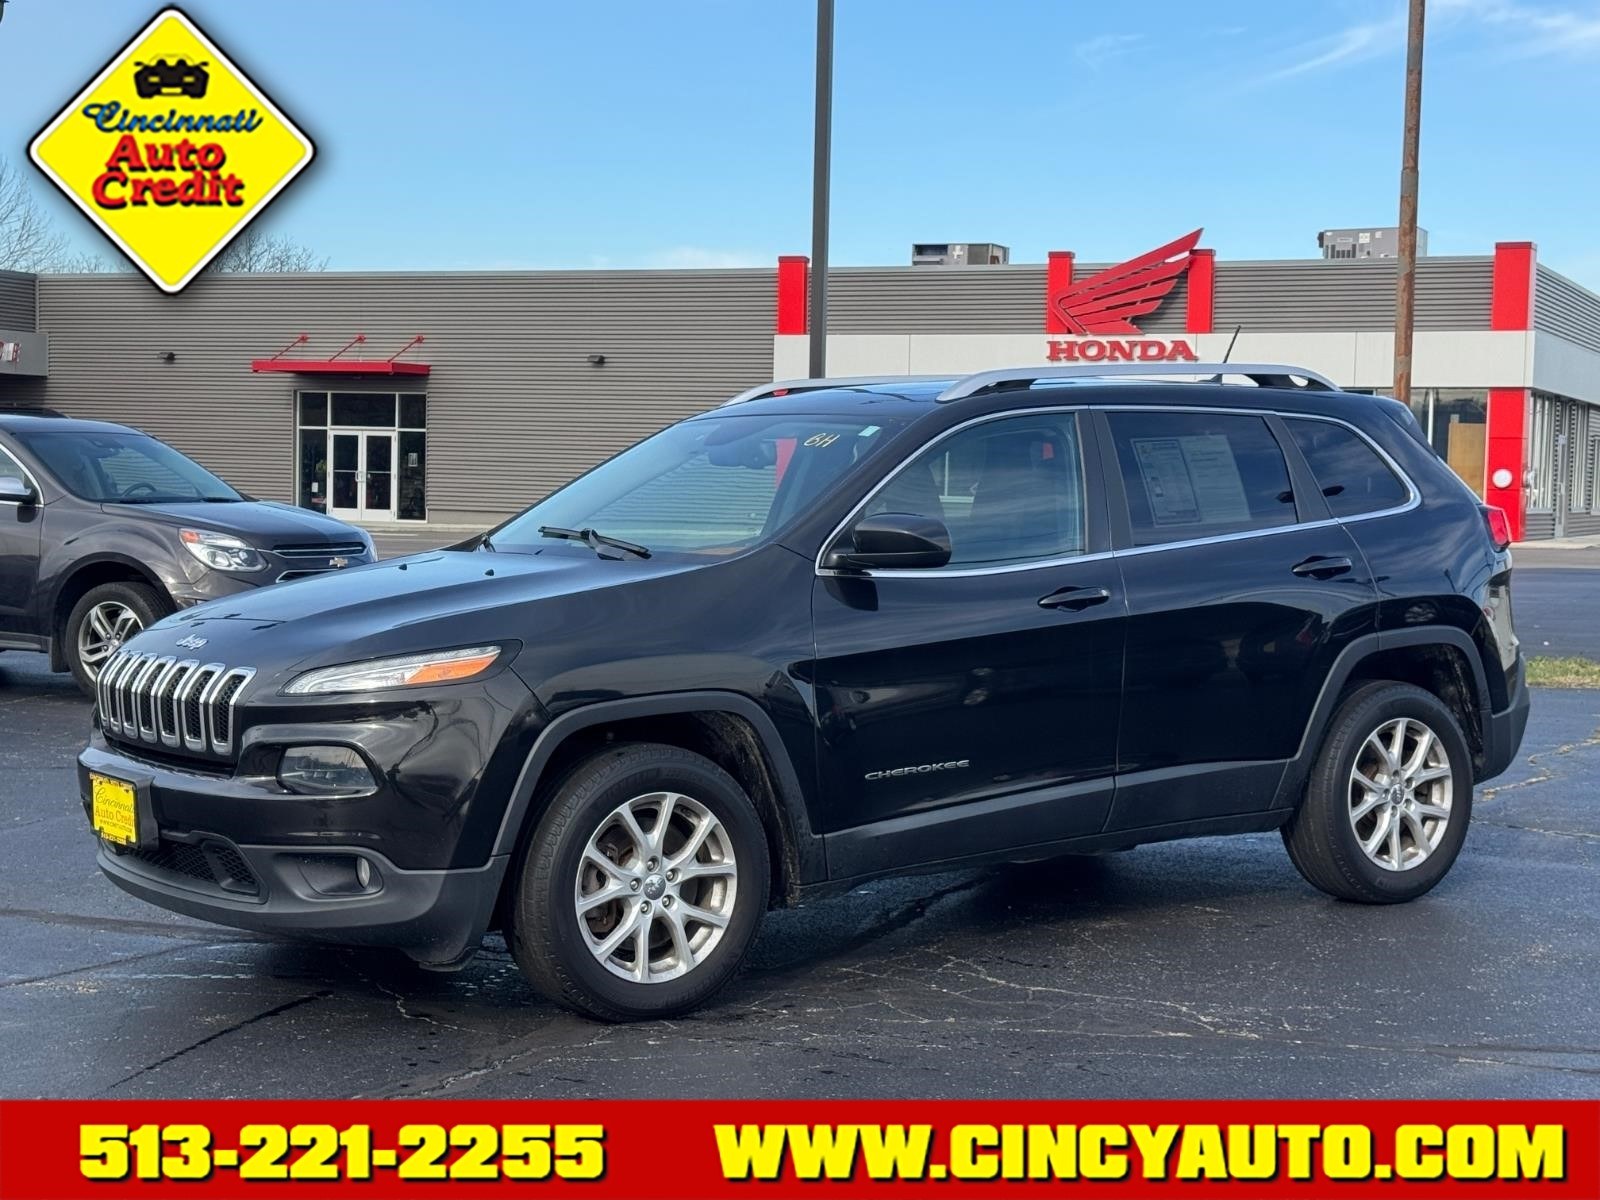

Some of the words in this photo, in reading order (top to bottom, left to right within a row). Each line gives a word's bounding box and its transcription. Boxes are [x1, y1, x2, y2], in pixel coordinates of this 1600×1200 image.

[1047, 340, 1199, 362] HONDA
[176, 633, 208, 651] Jeep
[864, 759, 970, 780] CHEROKEE
